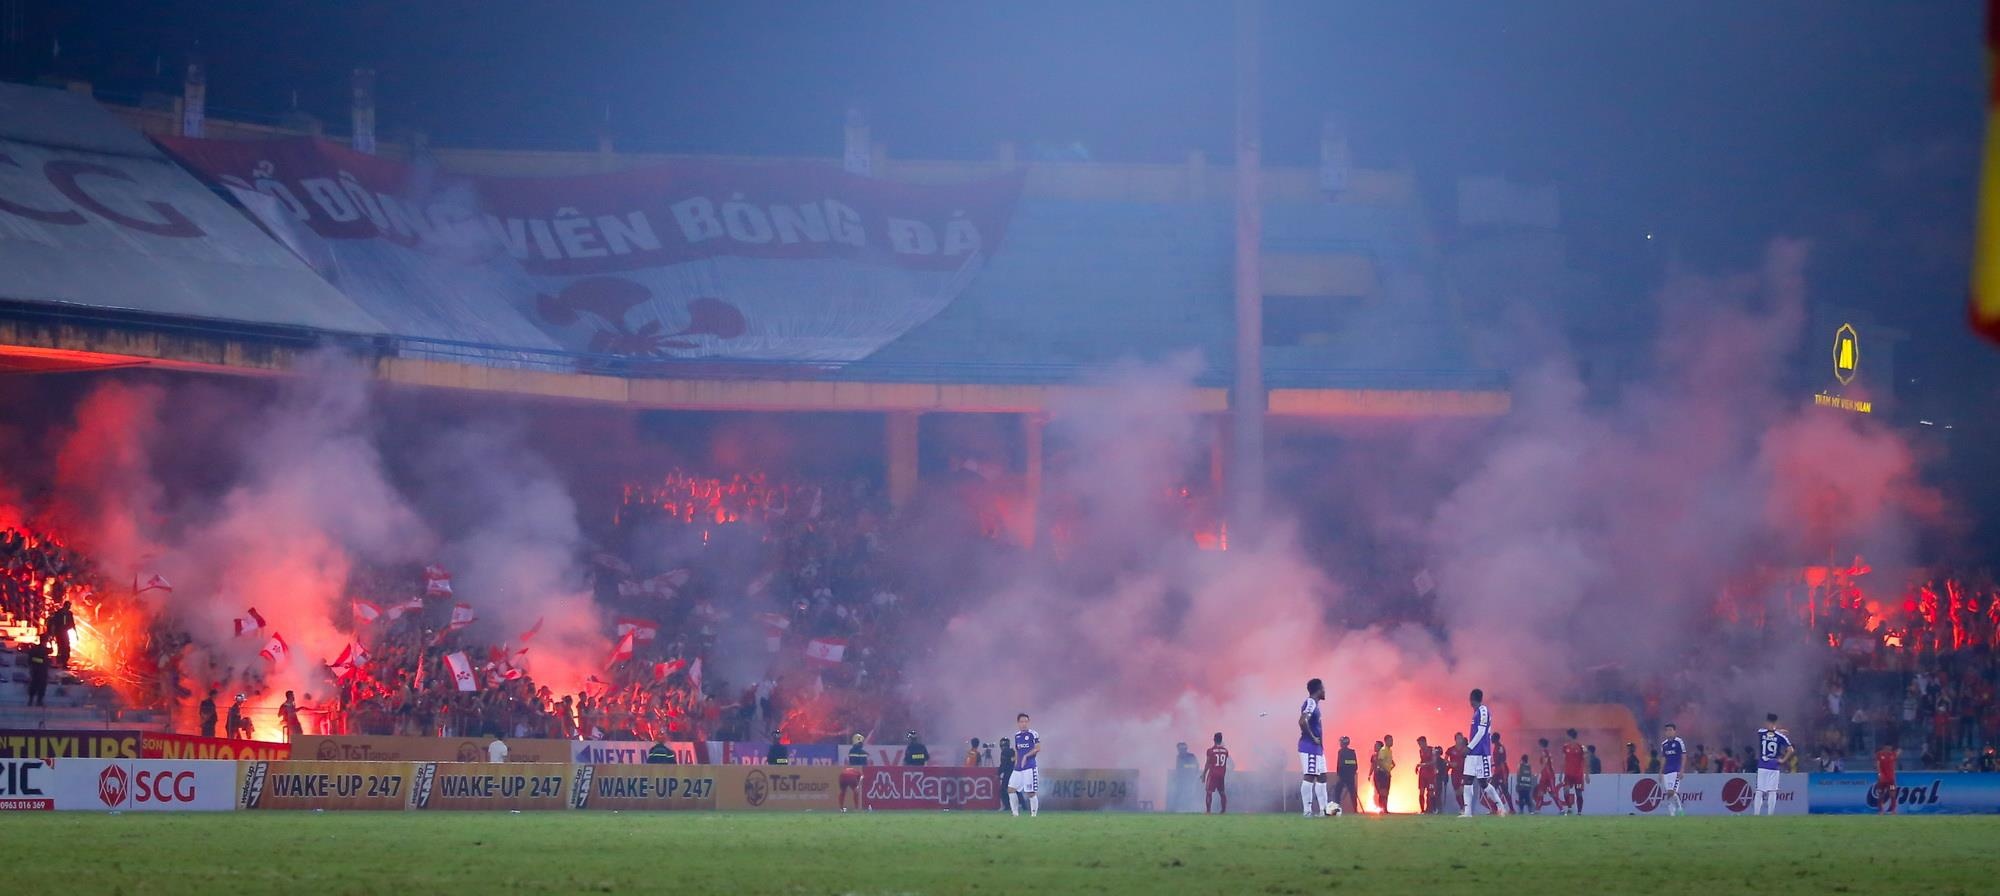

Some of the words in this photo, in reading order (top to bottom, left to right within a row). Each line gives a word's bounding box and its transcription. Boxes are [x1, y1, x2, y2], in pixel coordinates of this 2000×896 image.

[481, 206, 662, 261] VIÊN
[670, 192, 866, 246] BÓNG
[888, 209, 982, 256] ĐÁ
[594, 748, 635, 764] NEXT
[1761, 740, 1778, 757] 19
[1215, 754, 1226, 766] 19
[135, 771, 195, 802] SCG
[251, 762, 267, 807] 247
[272, 774, 363, 797] WAKE-UP
[368, 774, 402, 797] 247
[418, 764, 436, 807] 247
[440, 775, 525, 797] WAKE-UP
[530, 776, 562, 797] 247
[578, 766, 594, 807] 247
[598, 777, 678, 798] WAKE-UP
[683, 778, 713, 799] 247
[769, 774, 801, 791] T&T
[798, 782, 830, 792] GROUP
[902, 772, 994, 804] Kappa
[1051, 780, 1106, 798] AKE-UP
[0, 801, 17, 809] 0963
[18, 801, 31, 809] 016
[32, 801, 45, 809] 369
